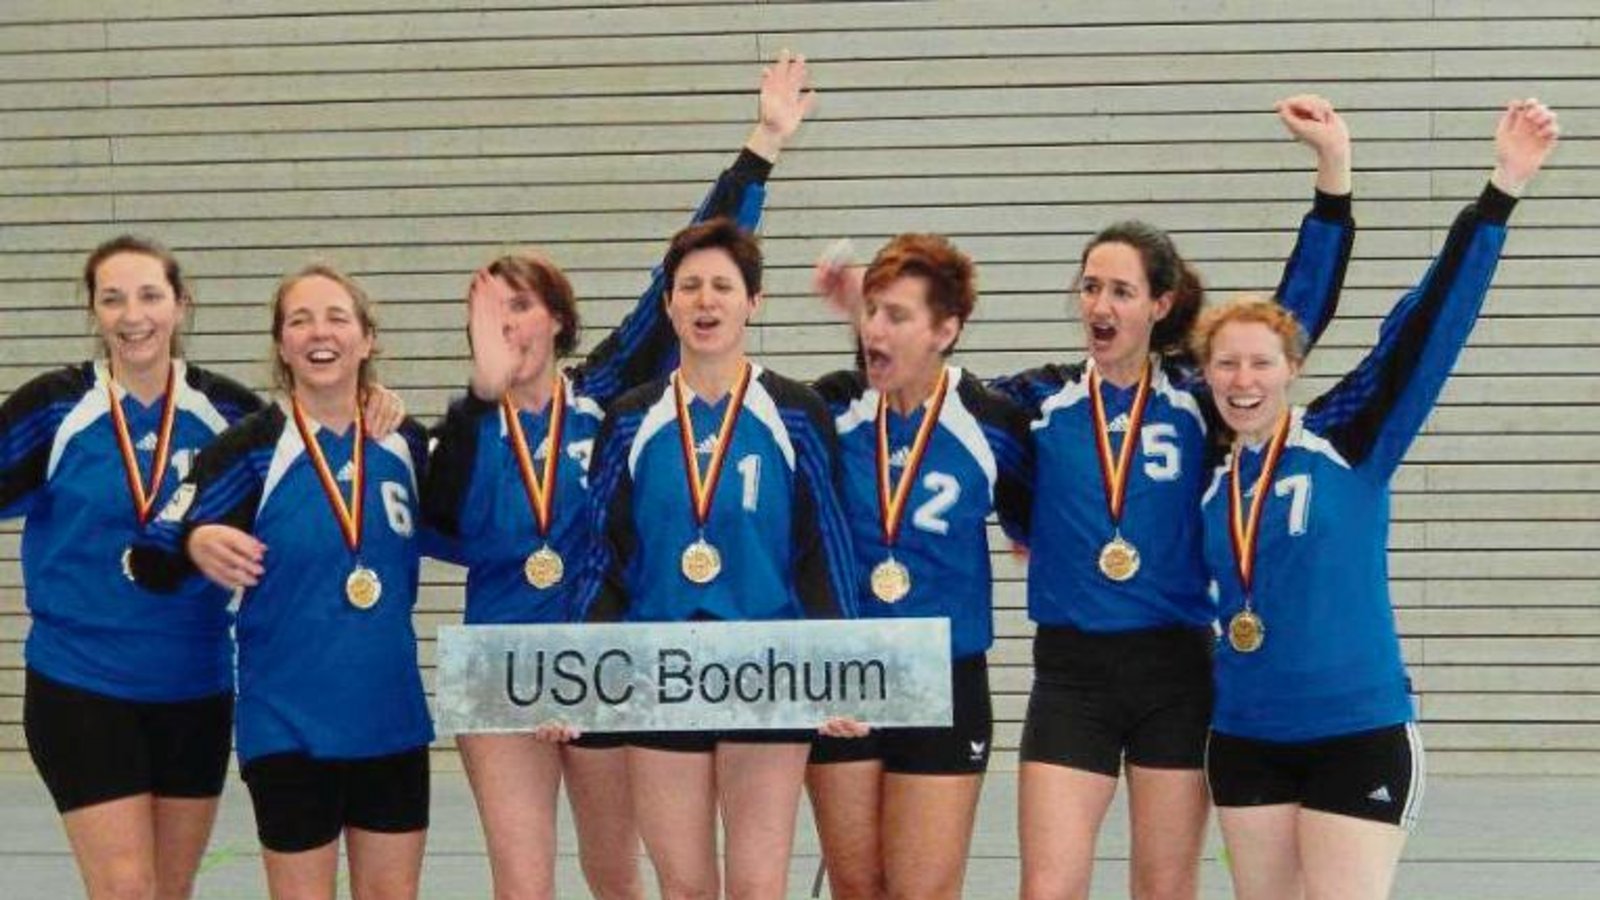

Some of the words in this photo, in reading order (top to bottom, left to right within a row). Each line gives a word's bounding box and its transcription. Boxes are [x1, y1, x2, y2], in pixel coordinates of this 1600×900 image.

[1141, 424, 1183, 482] 5
[381, 481, 413, 537] 6
[738, 454, 761, 513] 1
[913, 471, 962, 536] 2
[1274, 472, 1312, 537] 7
[505, 649, 634, 706] USC
[657, 648, 887, 704] Bochum
